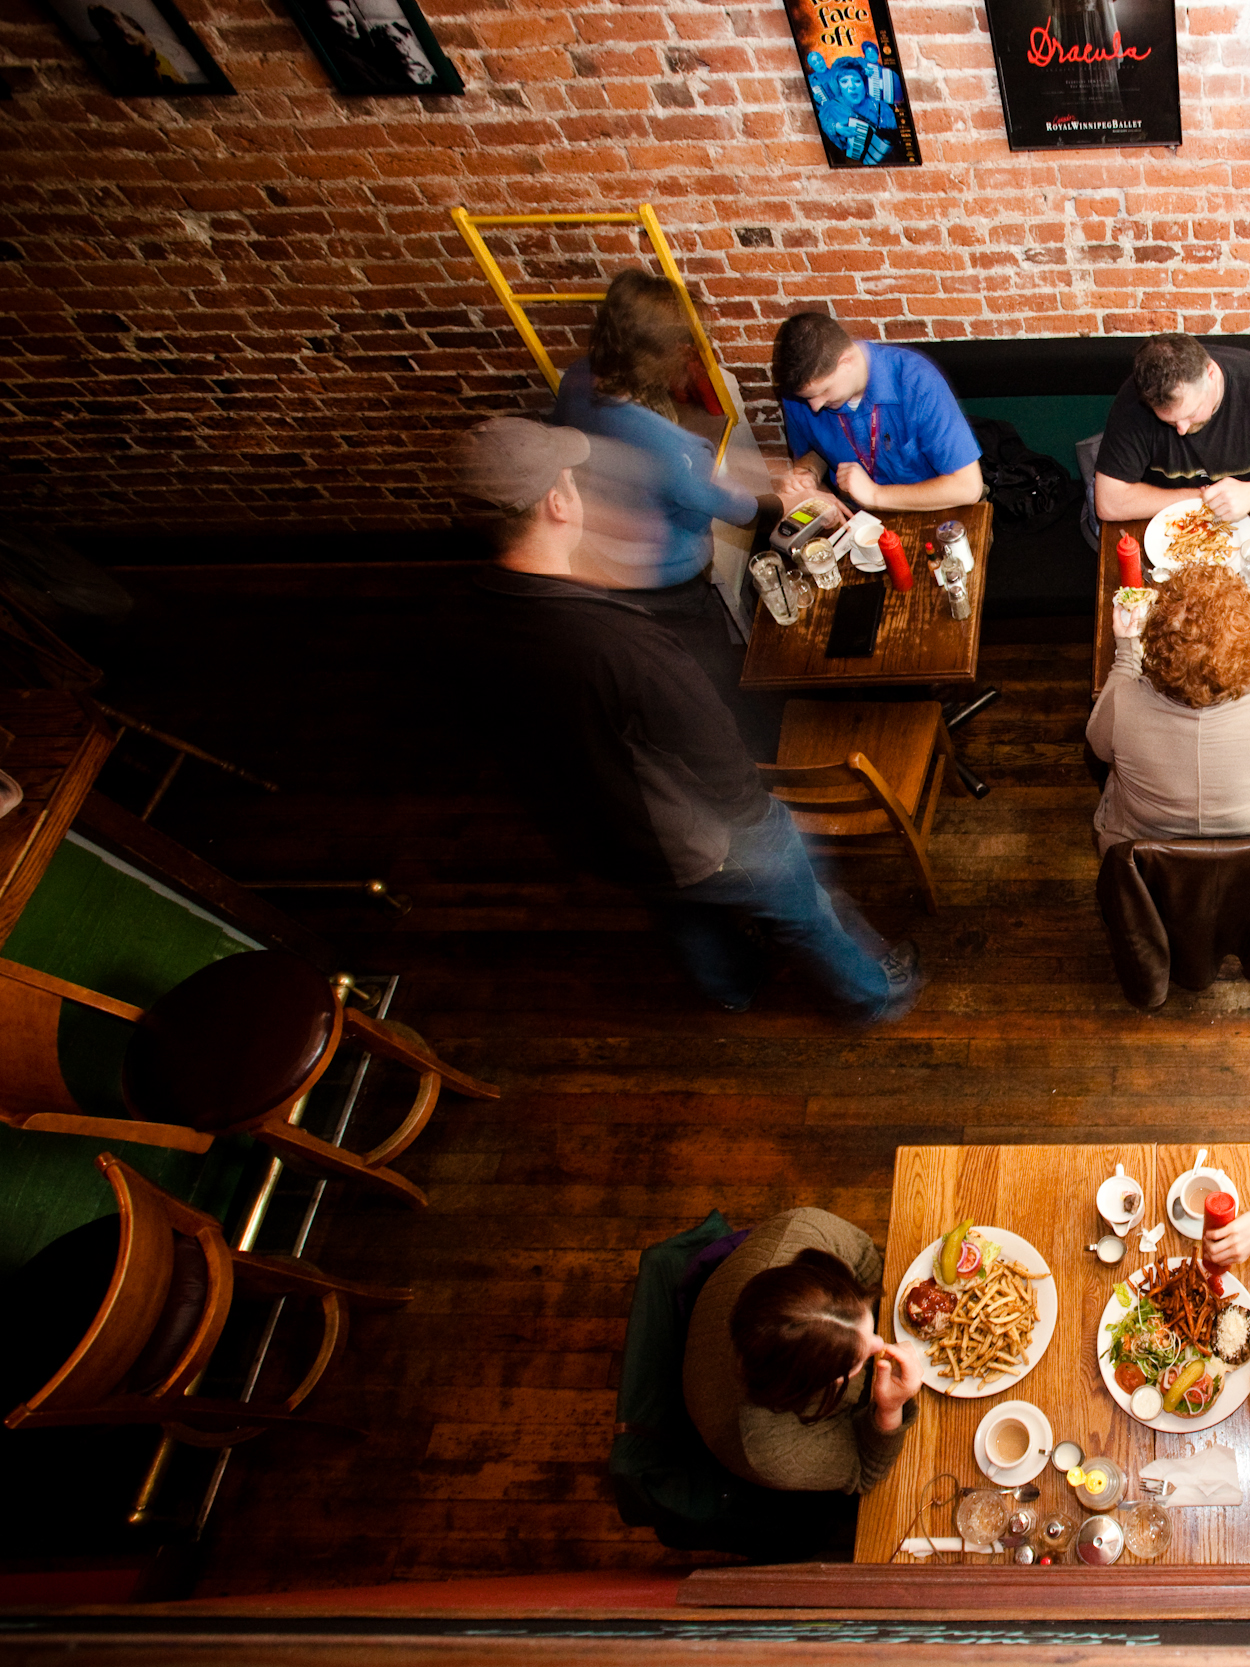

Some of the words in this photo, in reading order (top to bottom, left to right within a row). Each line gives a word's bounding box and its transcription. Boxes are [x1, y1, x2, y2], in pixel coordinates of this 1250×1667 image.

[818, 6, 869, 29] face
[821, 26, 856, 46] off
[1027, 16, 1152, 67] Dracula
